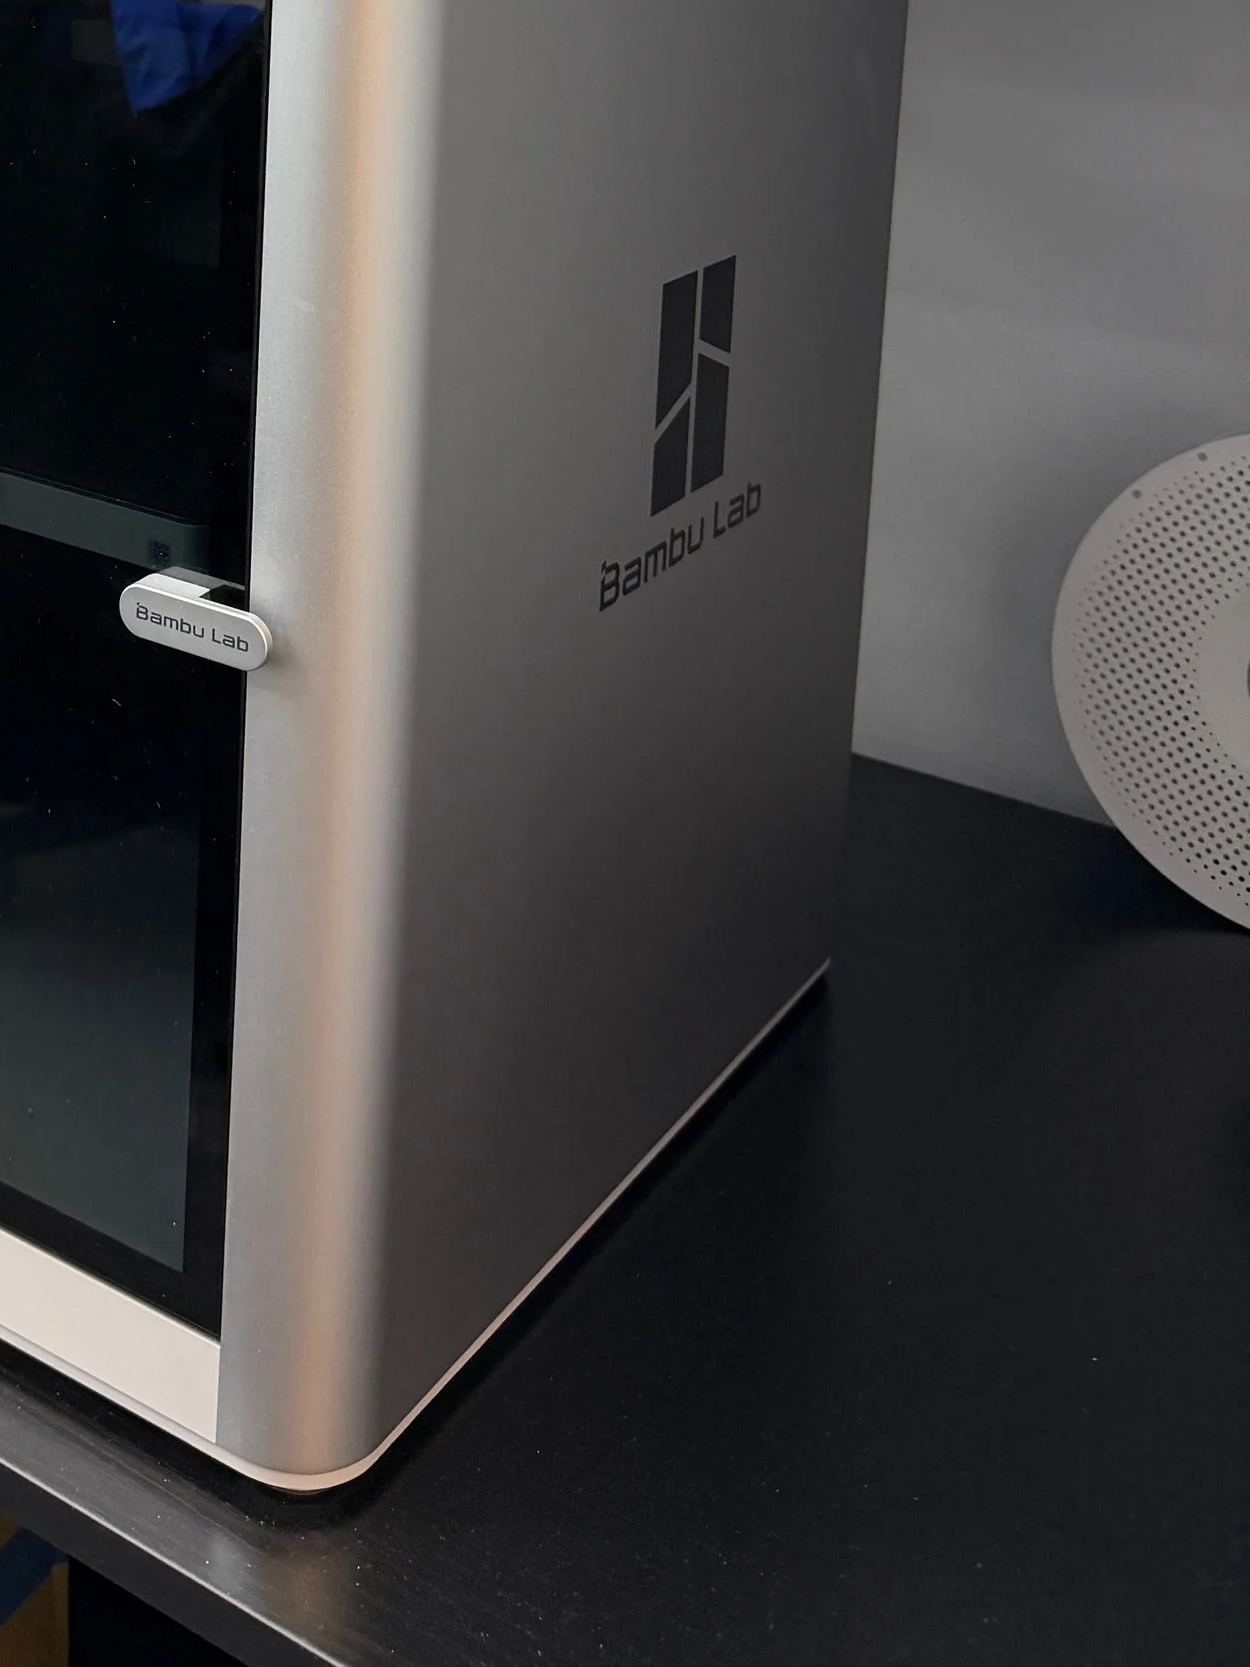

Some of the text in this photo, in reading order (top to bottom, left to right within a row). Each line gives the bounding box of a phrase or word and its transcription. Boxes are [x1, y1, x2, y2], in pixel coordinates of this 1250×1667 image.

[599, 481, 762, 613] Bambu Lab
[136, 602, 249, 652] Bambu Lab
